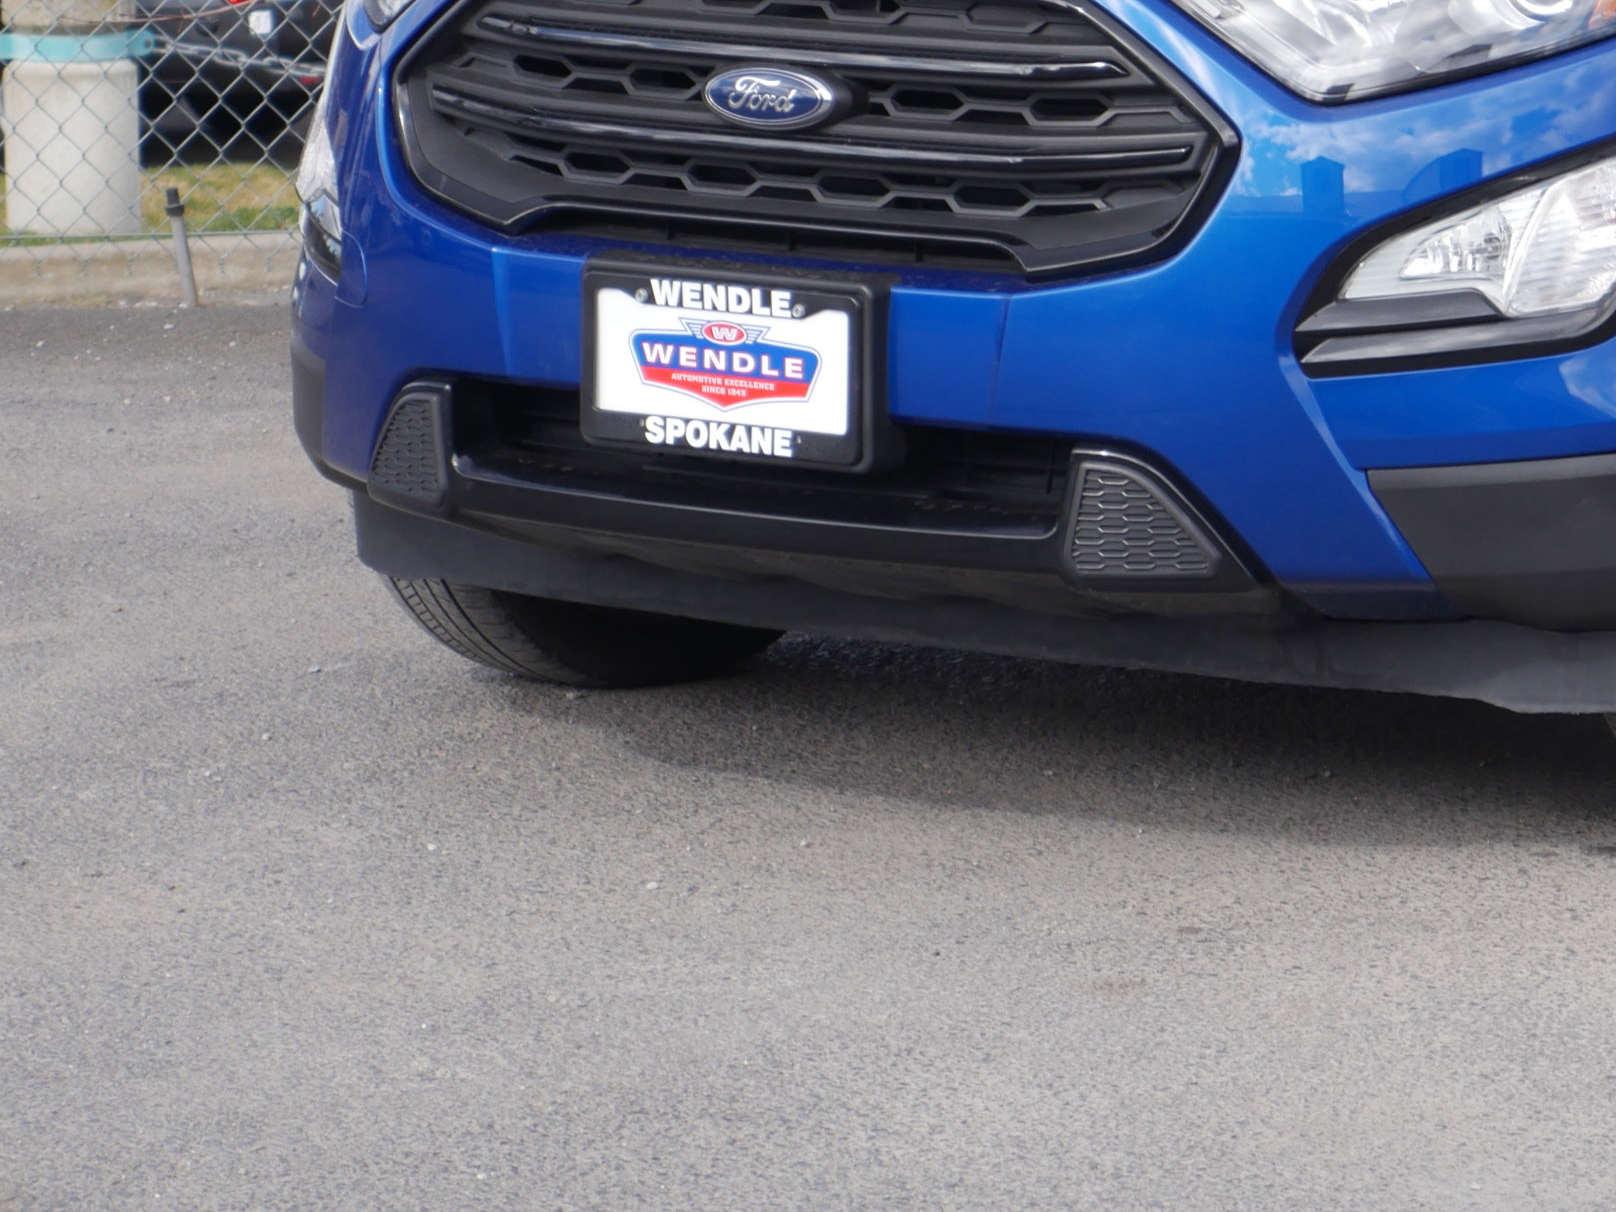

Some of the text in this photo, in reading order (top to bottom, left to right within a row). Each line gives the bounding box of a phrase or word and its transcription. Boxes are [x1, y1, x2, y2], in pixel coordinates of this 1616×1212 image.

[728, 76, 796, 112] Ford
[650, 278, 792, 318] WENDLE
[711, 326, 738, 341] W
[642, 343, 803, 378] WENDLE
[671, 373, 775, 391] AUTOMOTIVE EXCELLENCE
[701, 385, 726, 395] SINCE
[645, 416, 793, 458] SPOKANE
